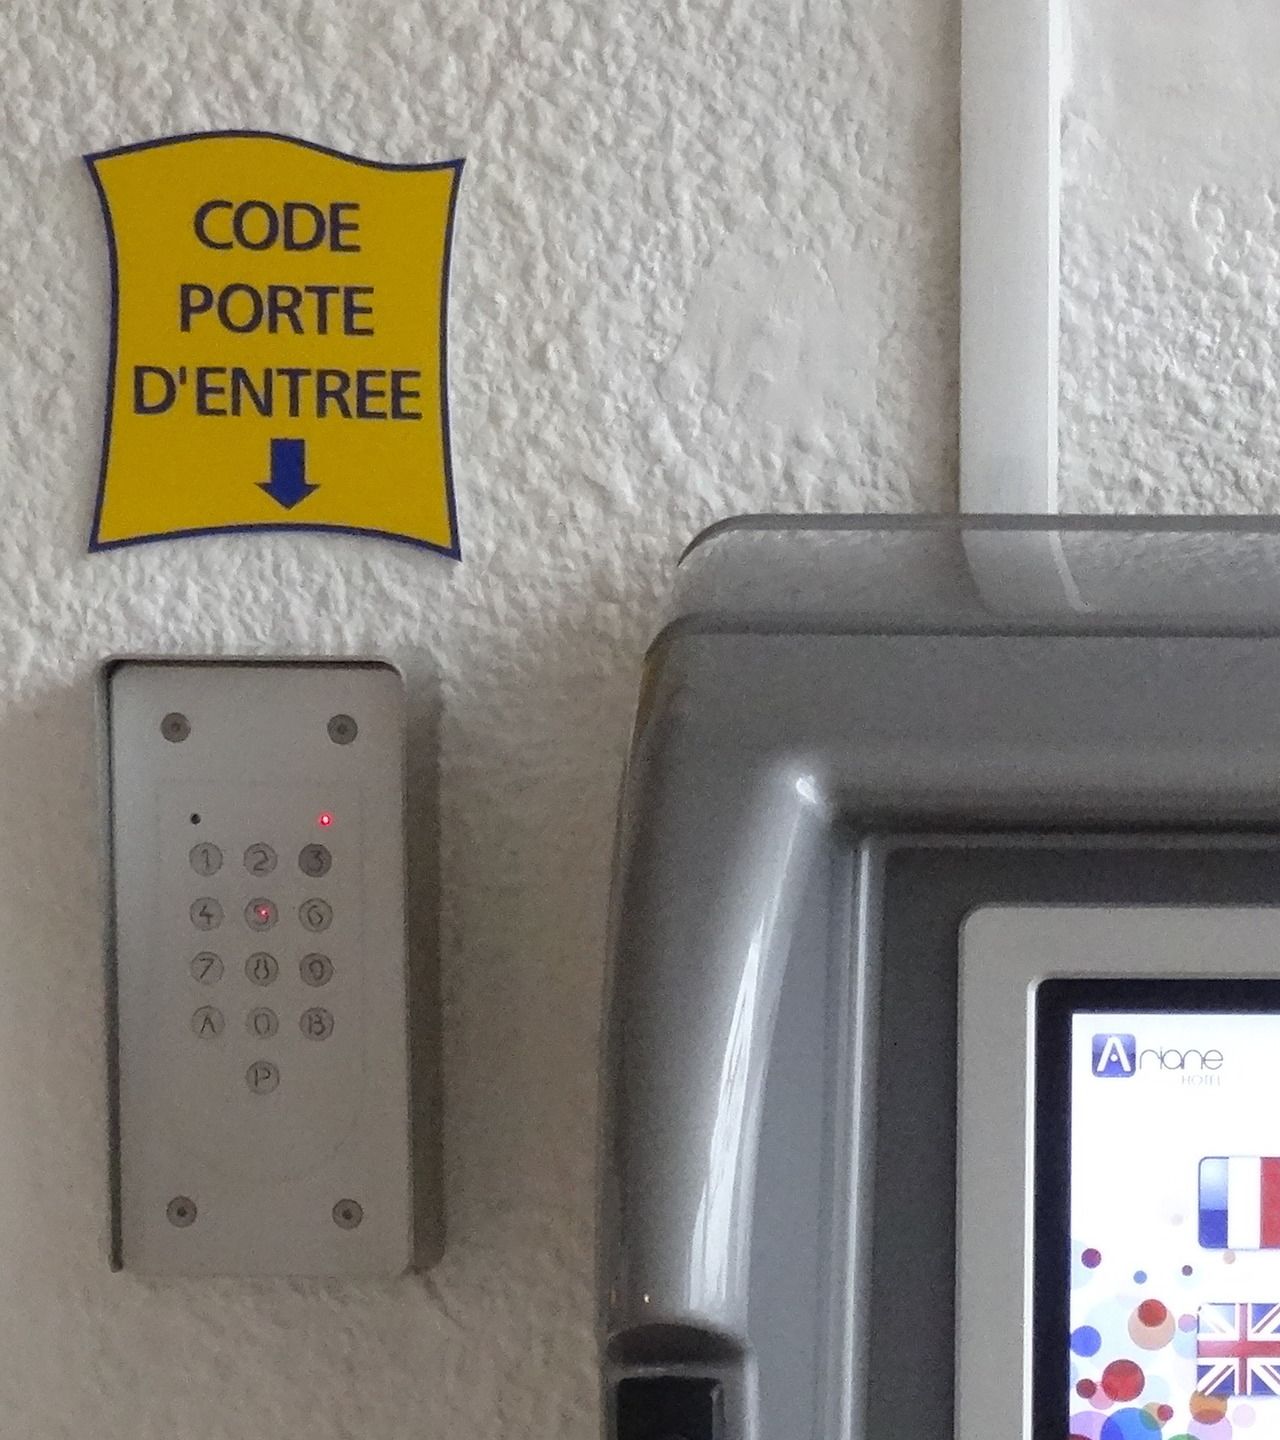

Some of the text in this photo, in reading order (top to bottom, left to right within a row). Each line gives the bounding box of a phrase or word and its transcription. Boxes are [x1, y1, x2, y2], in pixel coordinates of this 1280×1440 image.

[193, 200, 362, 253] CODE
[179, 283, 375, 336] PORTE
[133, 365, 423, 420] D'ENTREE
[252, 850, 269, 871] 2
[308, 850, 325, 873] 3
[199, 905, 214, 925] 4
[307, 904, 324, 926] 6
[199, 957, 215, 980] 7
[200, 1014, 216, 1033] A
[308, 1013, 326, 1036] B
[254, 1068, 272, 1087] P
